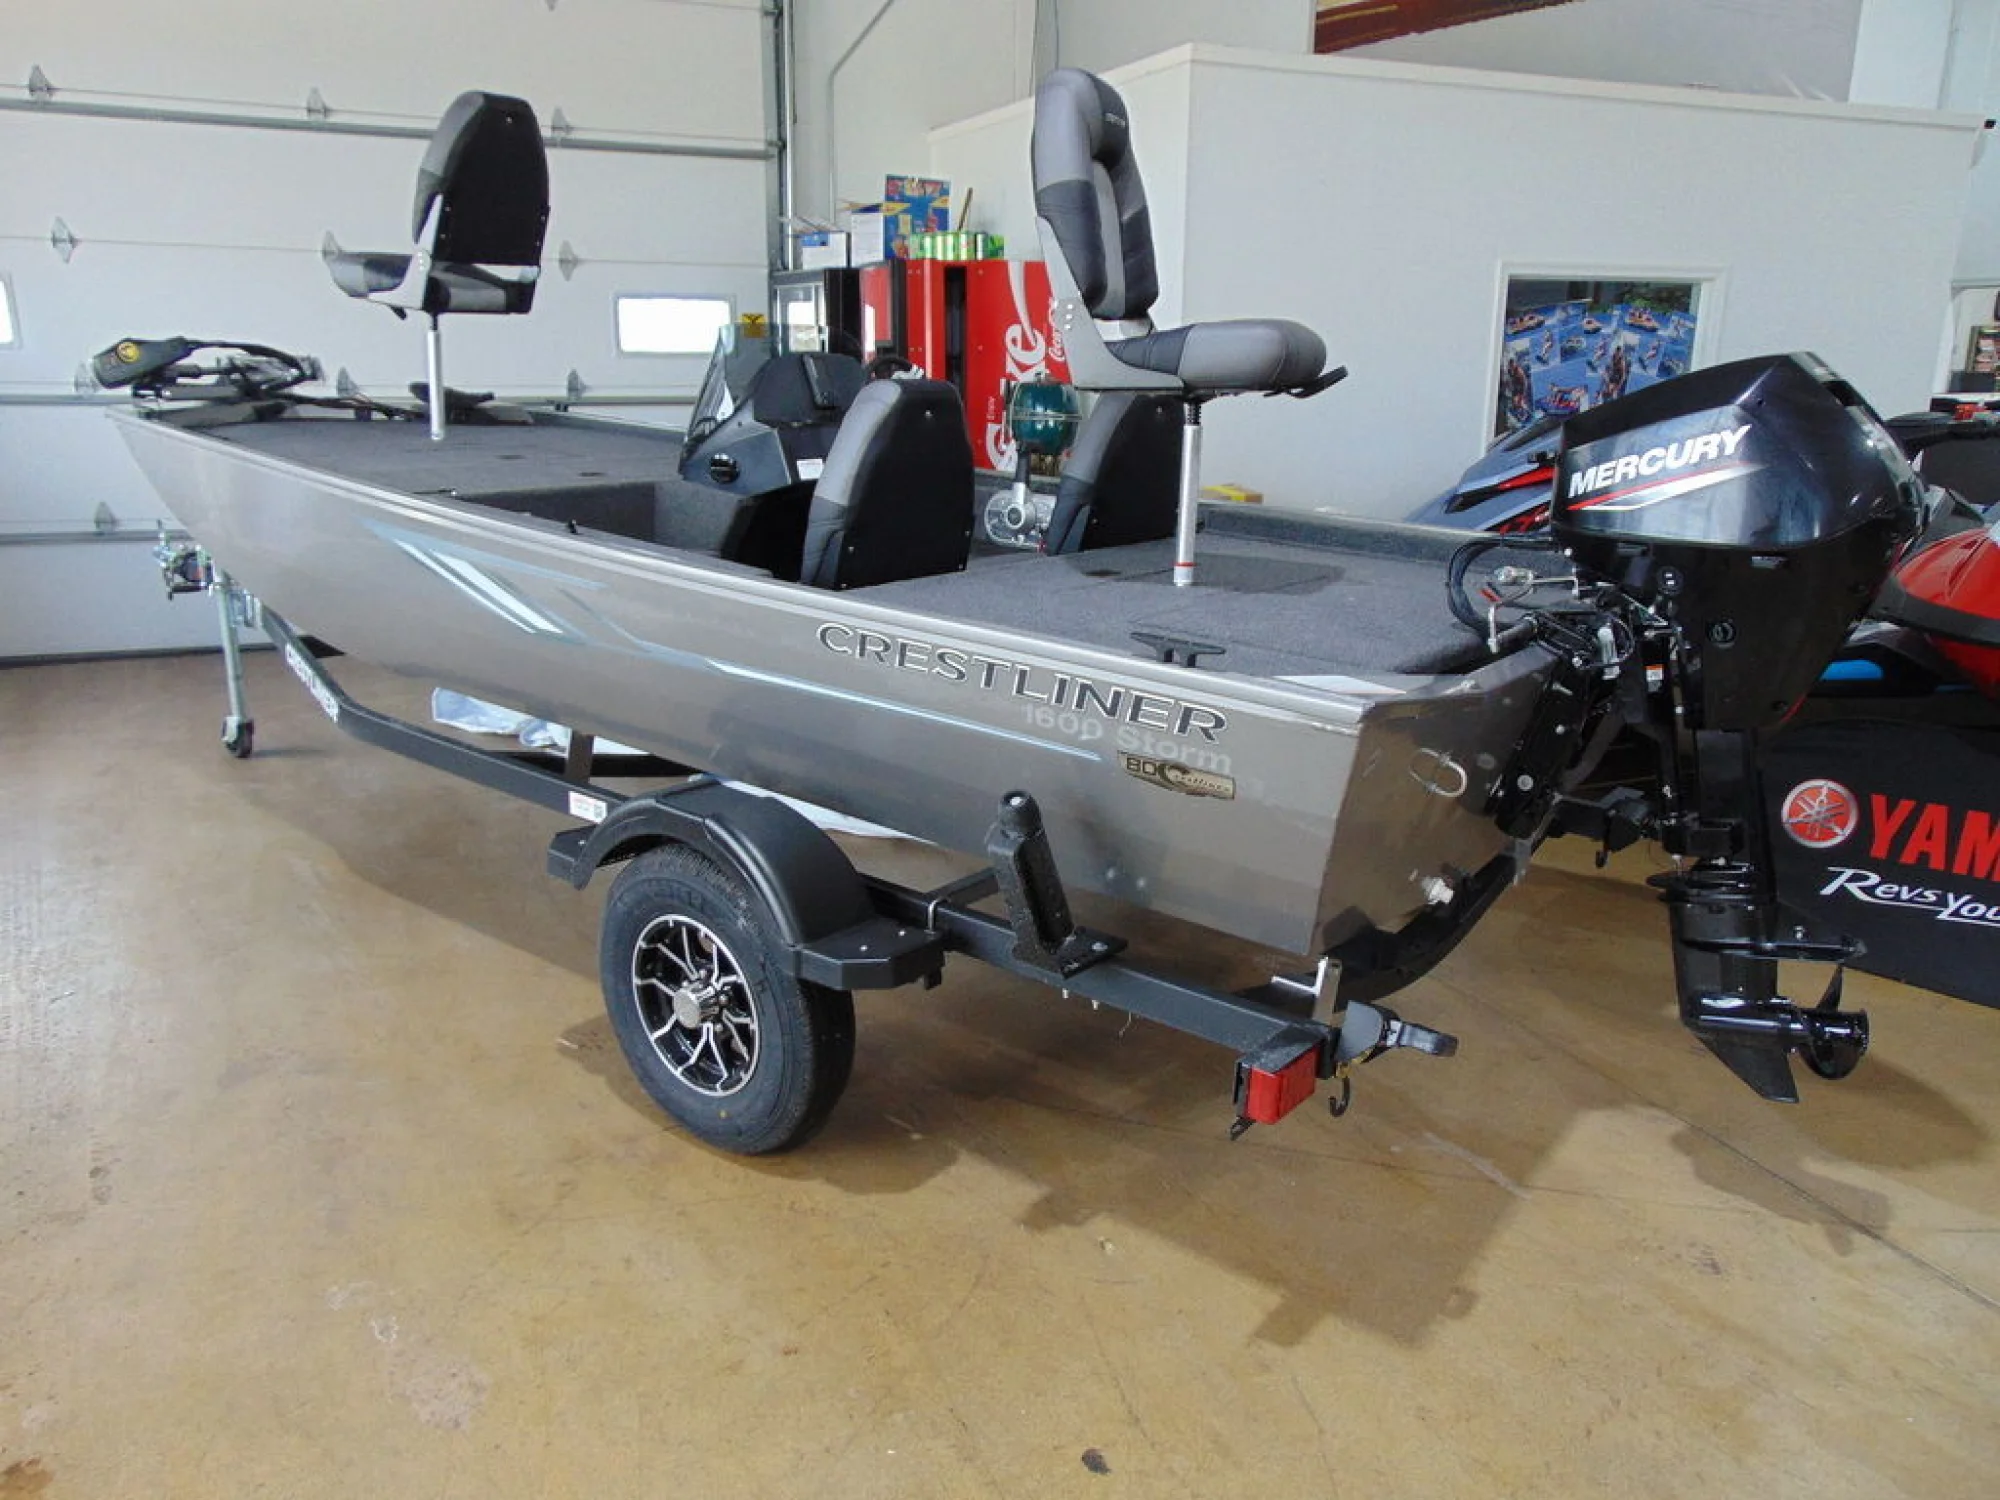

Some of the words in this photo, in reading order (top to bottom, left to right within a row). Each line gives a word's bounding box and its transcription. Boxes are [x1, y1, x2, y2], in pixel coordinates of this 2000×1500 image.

[1567, 424, 1753, 499] MERCURY
[815, 622, 1228, 744] CRESTLINER
[1116, 725, 1232, 774] Storm
[1869, 794, 2000, 882] YAM
[1820, 866, 1946, 910] Revs
